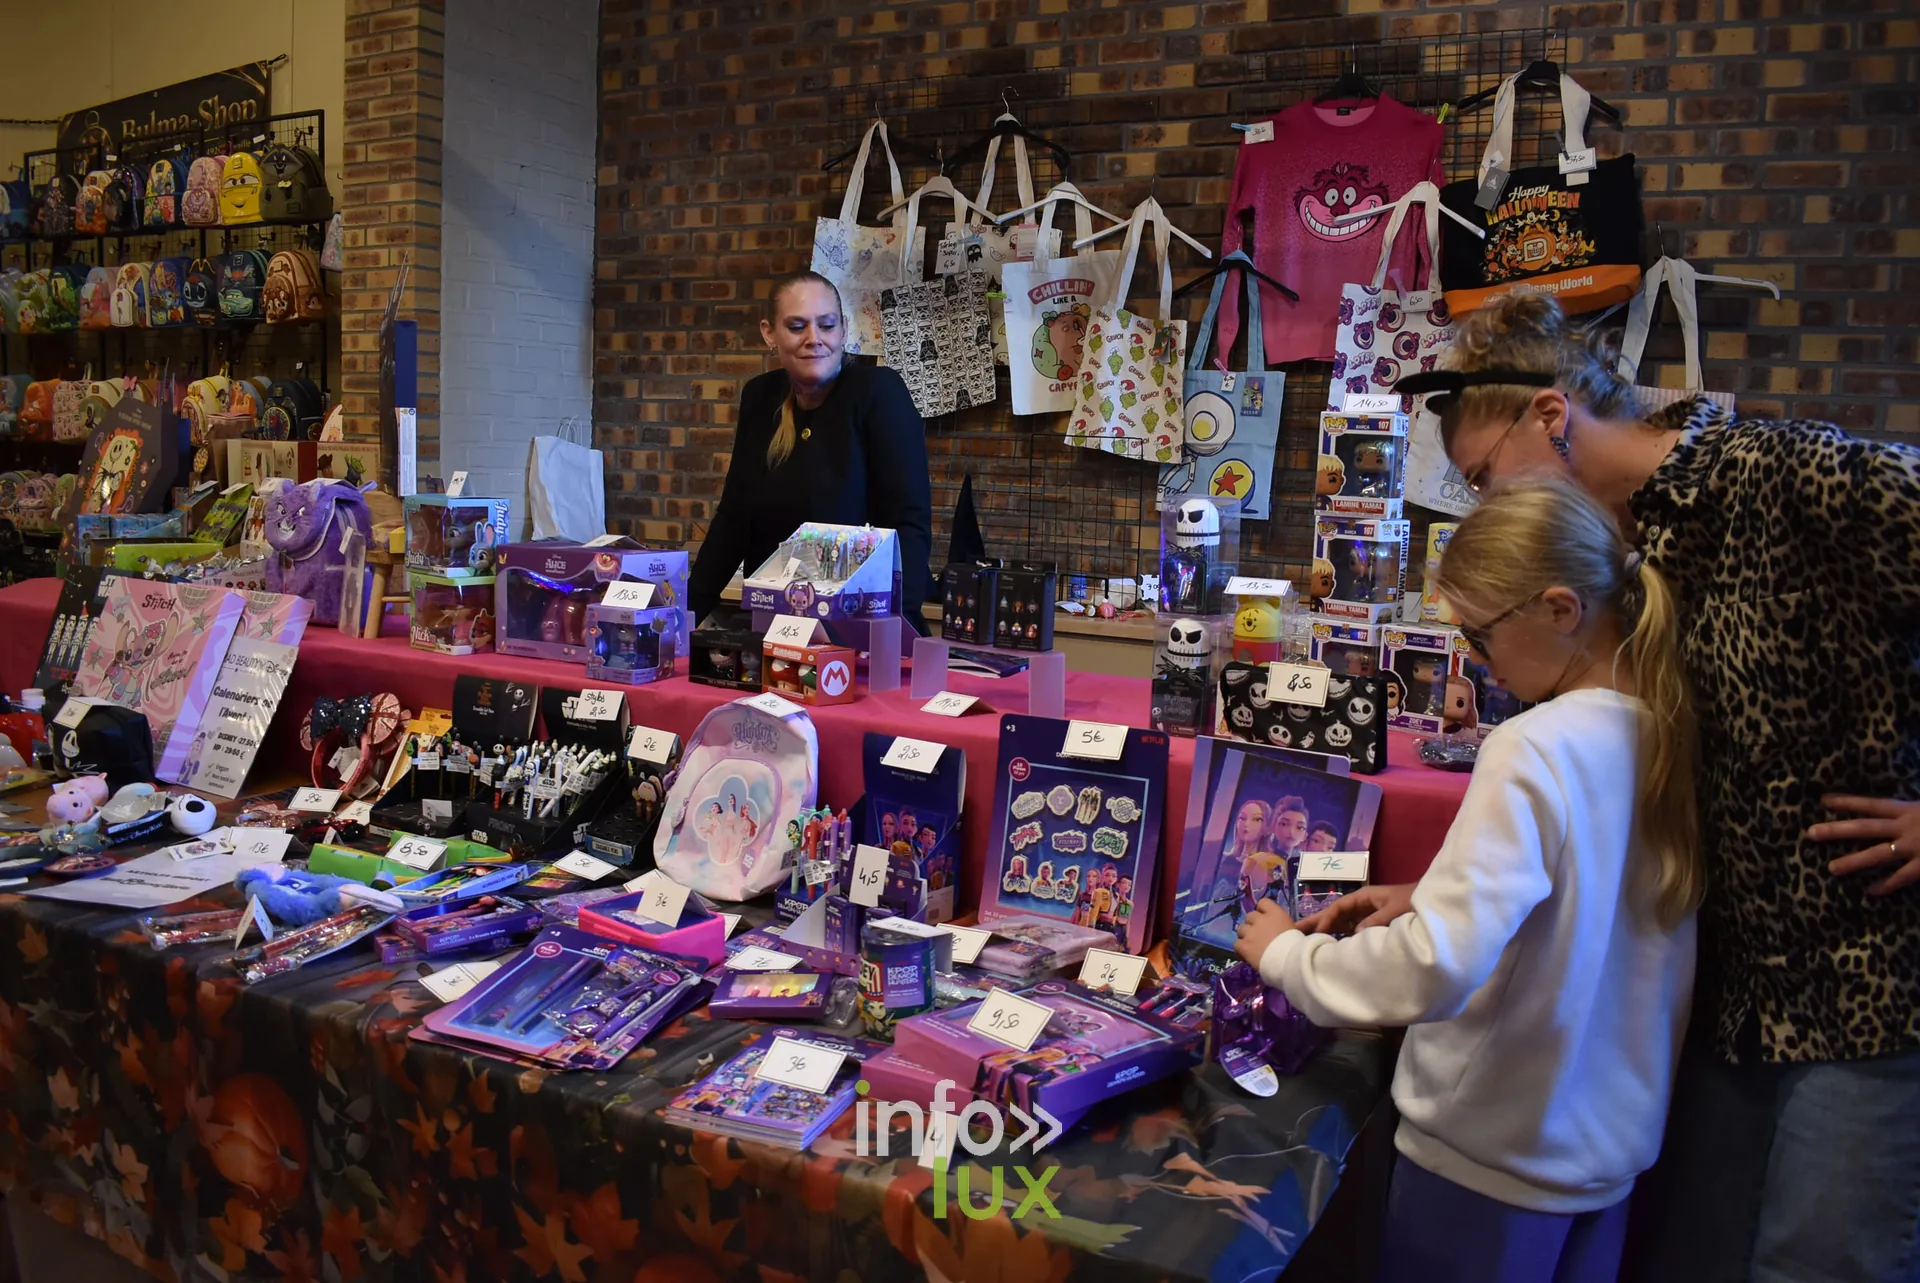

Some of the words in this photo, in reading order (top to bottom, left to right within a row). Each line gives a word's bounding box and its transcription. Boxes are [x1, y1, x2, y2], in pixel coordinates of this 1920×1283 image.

[1508, 184, 1550, 203] Happy
[1485, 191, 1581, 226] HALLOWEEN
[1560, 275, 1593, 290] World
[1032, 281, 1092, 301] CHILLIN'
[1052, 297, 1069, 305] LIKE
[1355, 297, 1381, 316] LOTSO
[1409, 296, 1423, 307] 6,50
[1421, 328, 1457, 349] LOTSO
[1348, 352, 1375, 370] LOTSO
[1128, 365, 1145, 381] GRINCH
[1140, 391, 1160, 401] GRINCH
[1353, 397, 1389, 408] 14,50
[1118, 413, 1136, 428] GRINCH
[1323, 415, 1348, 430] POP!
[1378, 419, 1390, 431] 107
[1428, 498, 1454, 509] WHERE
[494, 501, 508, 538] Judy
[1363, 526, 1374, 536] 107
[1400, 524, 1409, 564] LAMINE
[406, 550, 424, 566] Judy
[545, 558, 567, 570] ALICE
[1397, 567, 1407, 603] YAMAL
[613, 588, 639, 601] 13,50
[1327, 602, 1348, 612] LAMINE
[1349, 606, 1368, 614] YAMAL
[411, 625, 430, 643] Nick
[775, 626, 800, 638] 12,50
[1357, 630, 1368, 640] 107
[235, 654, 261, 668] BEAUTY
[1287, 673, 1312, 692] 8,50
[589, 707, 607, 717] 2,50
[1006, 724, 1016, 732] +3
[218, 732, 237, 742] DISNEY
[643, 737, 656, 752] 2€
[1081, 730, 1105, 744] 5€
[1141, 735, 1165, 745] NETFLIX
[897, 745, 921, 760] 2,50
[472, 829, 488, 838] STAR
[399, 842, 428, 856] 8,50
[1318, 856, 1344, 871] 7€
[858, 867, 880, 886] 4,5
[1100, 964, 1117, 982] 2€
[989, 1008, 1020, 1030] 9,50
[785, 1056, 806, 1073] 3€
